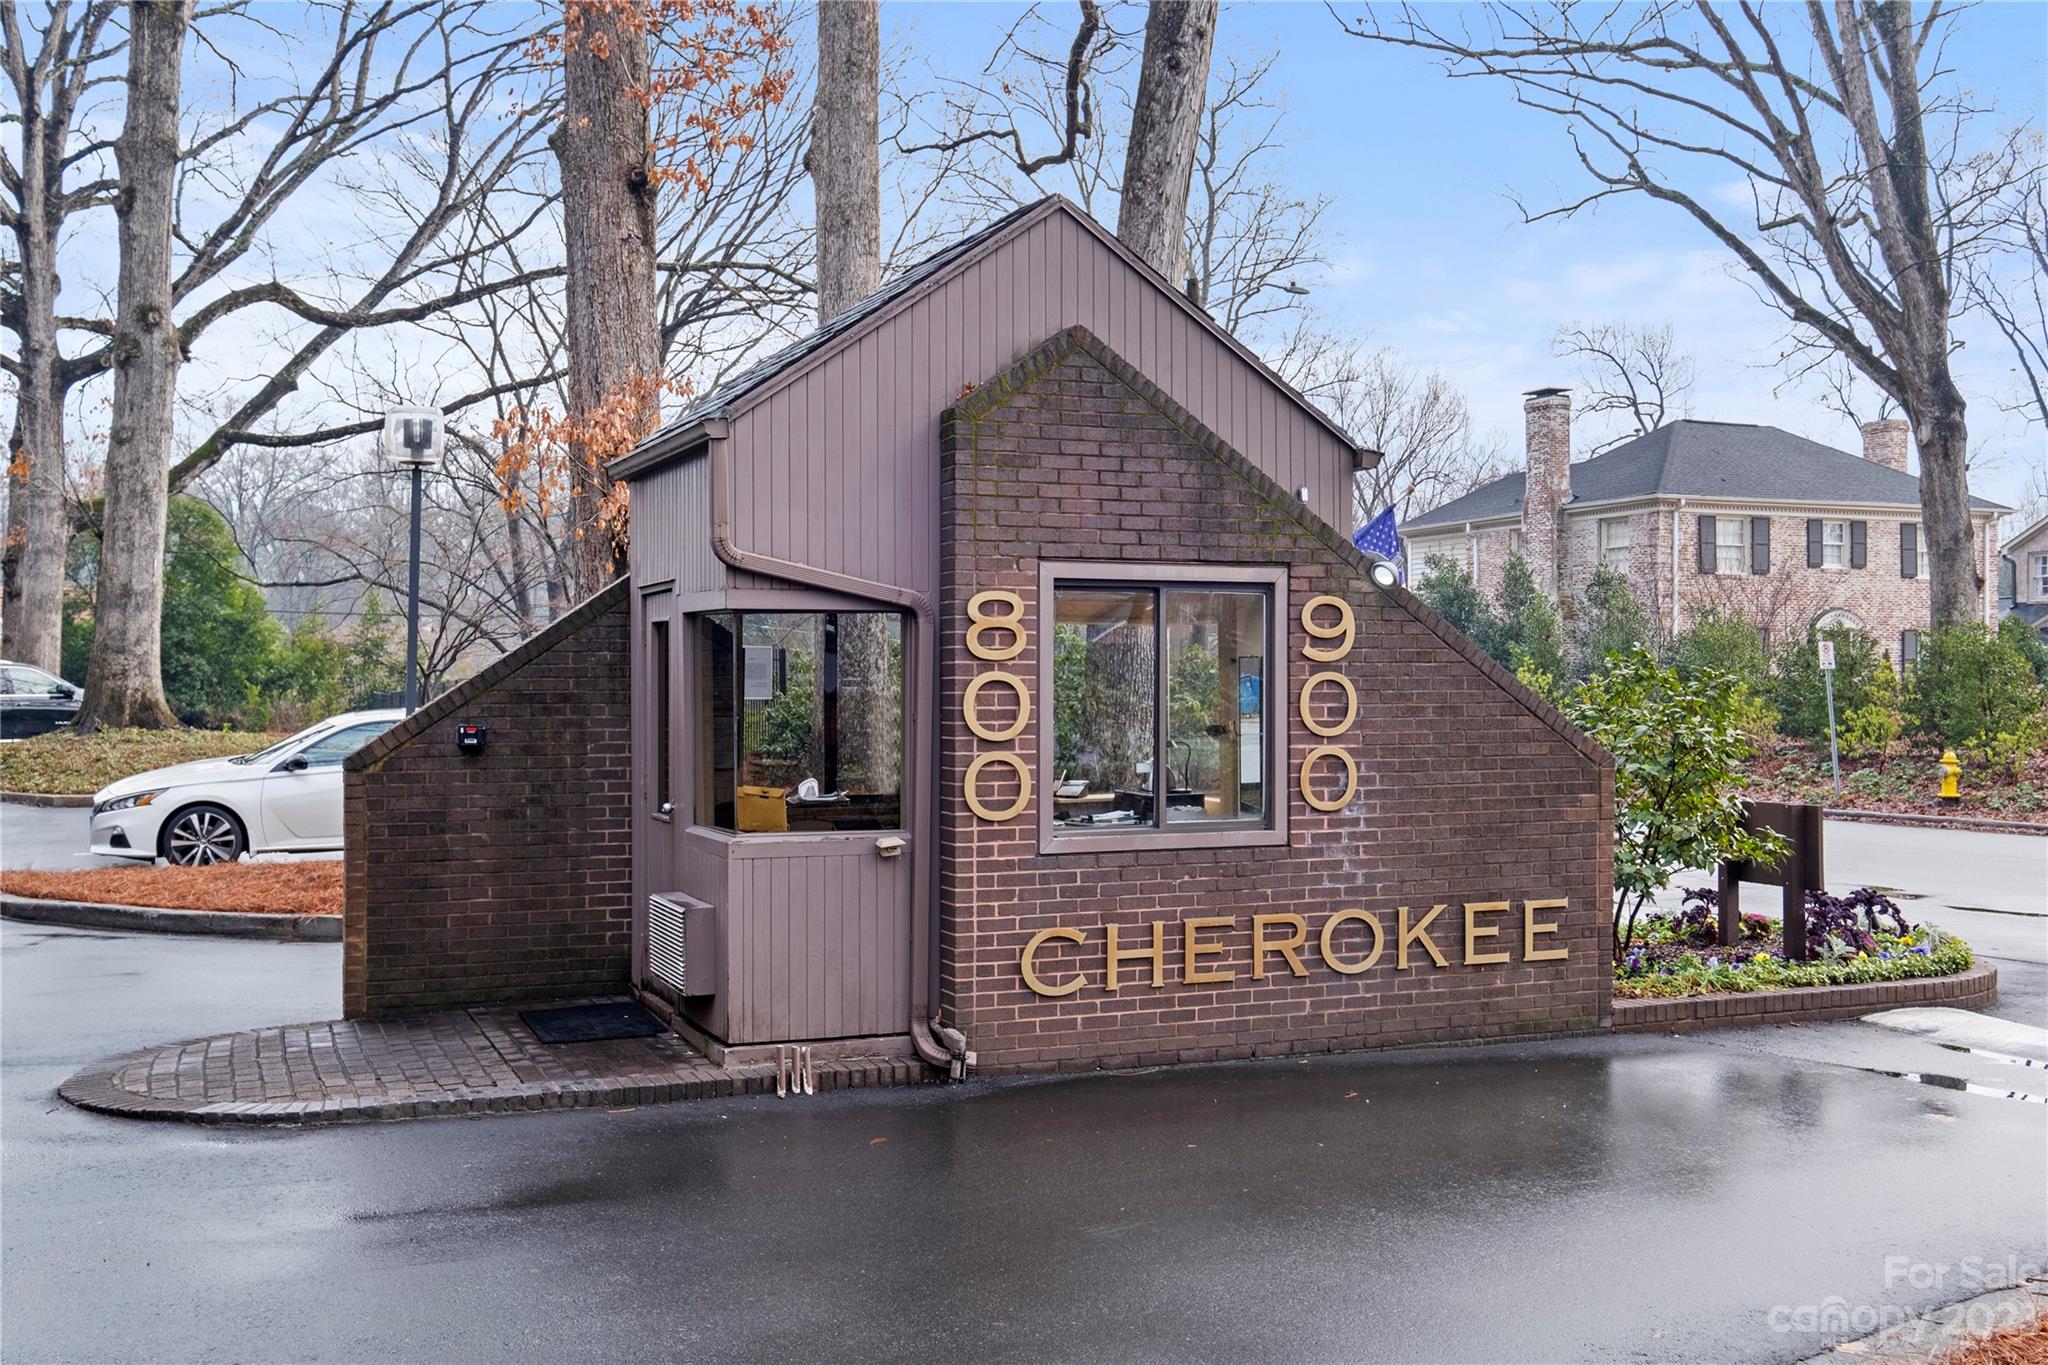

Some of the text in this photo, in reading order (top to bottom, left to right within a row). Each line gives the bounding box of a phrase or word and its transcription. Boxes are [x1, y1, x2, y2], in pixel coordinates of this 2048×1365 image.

[962, 590, 1032, 822] 800
[1299, 595, 1358, 812] 900
[1020, 896, 1570, 997] CHEROKEE
